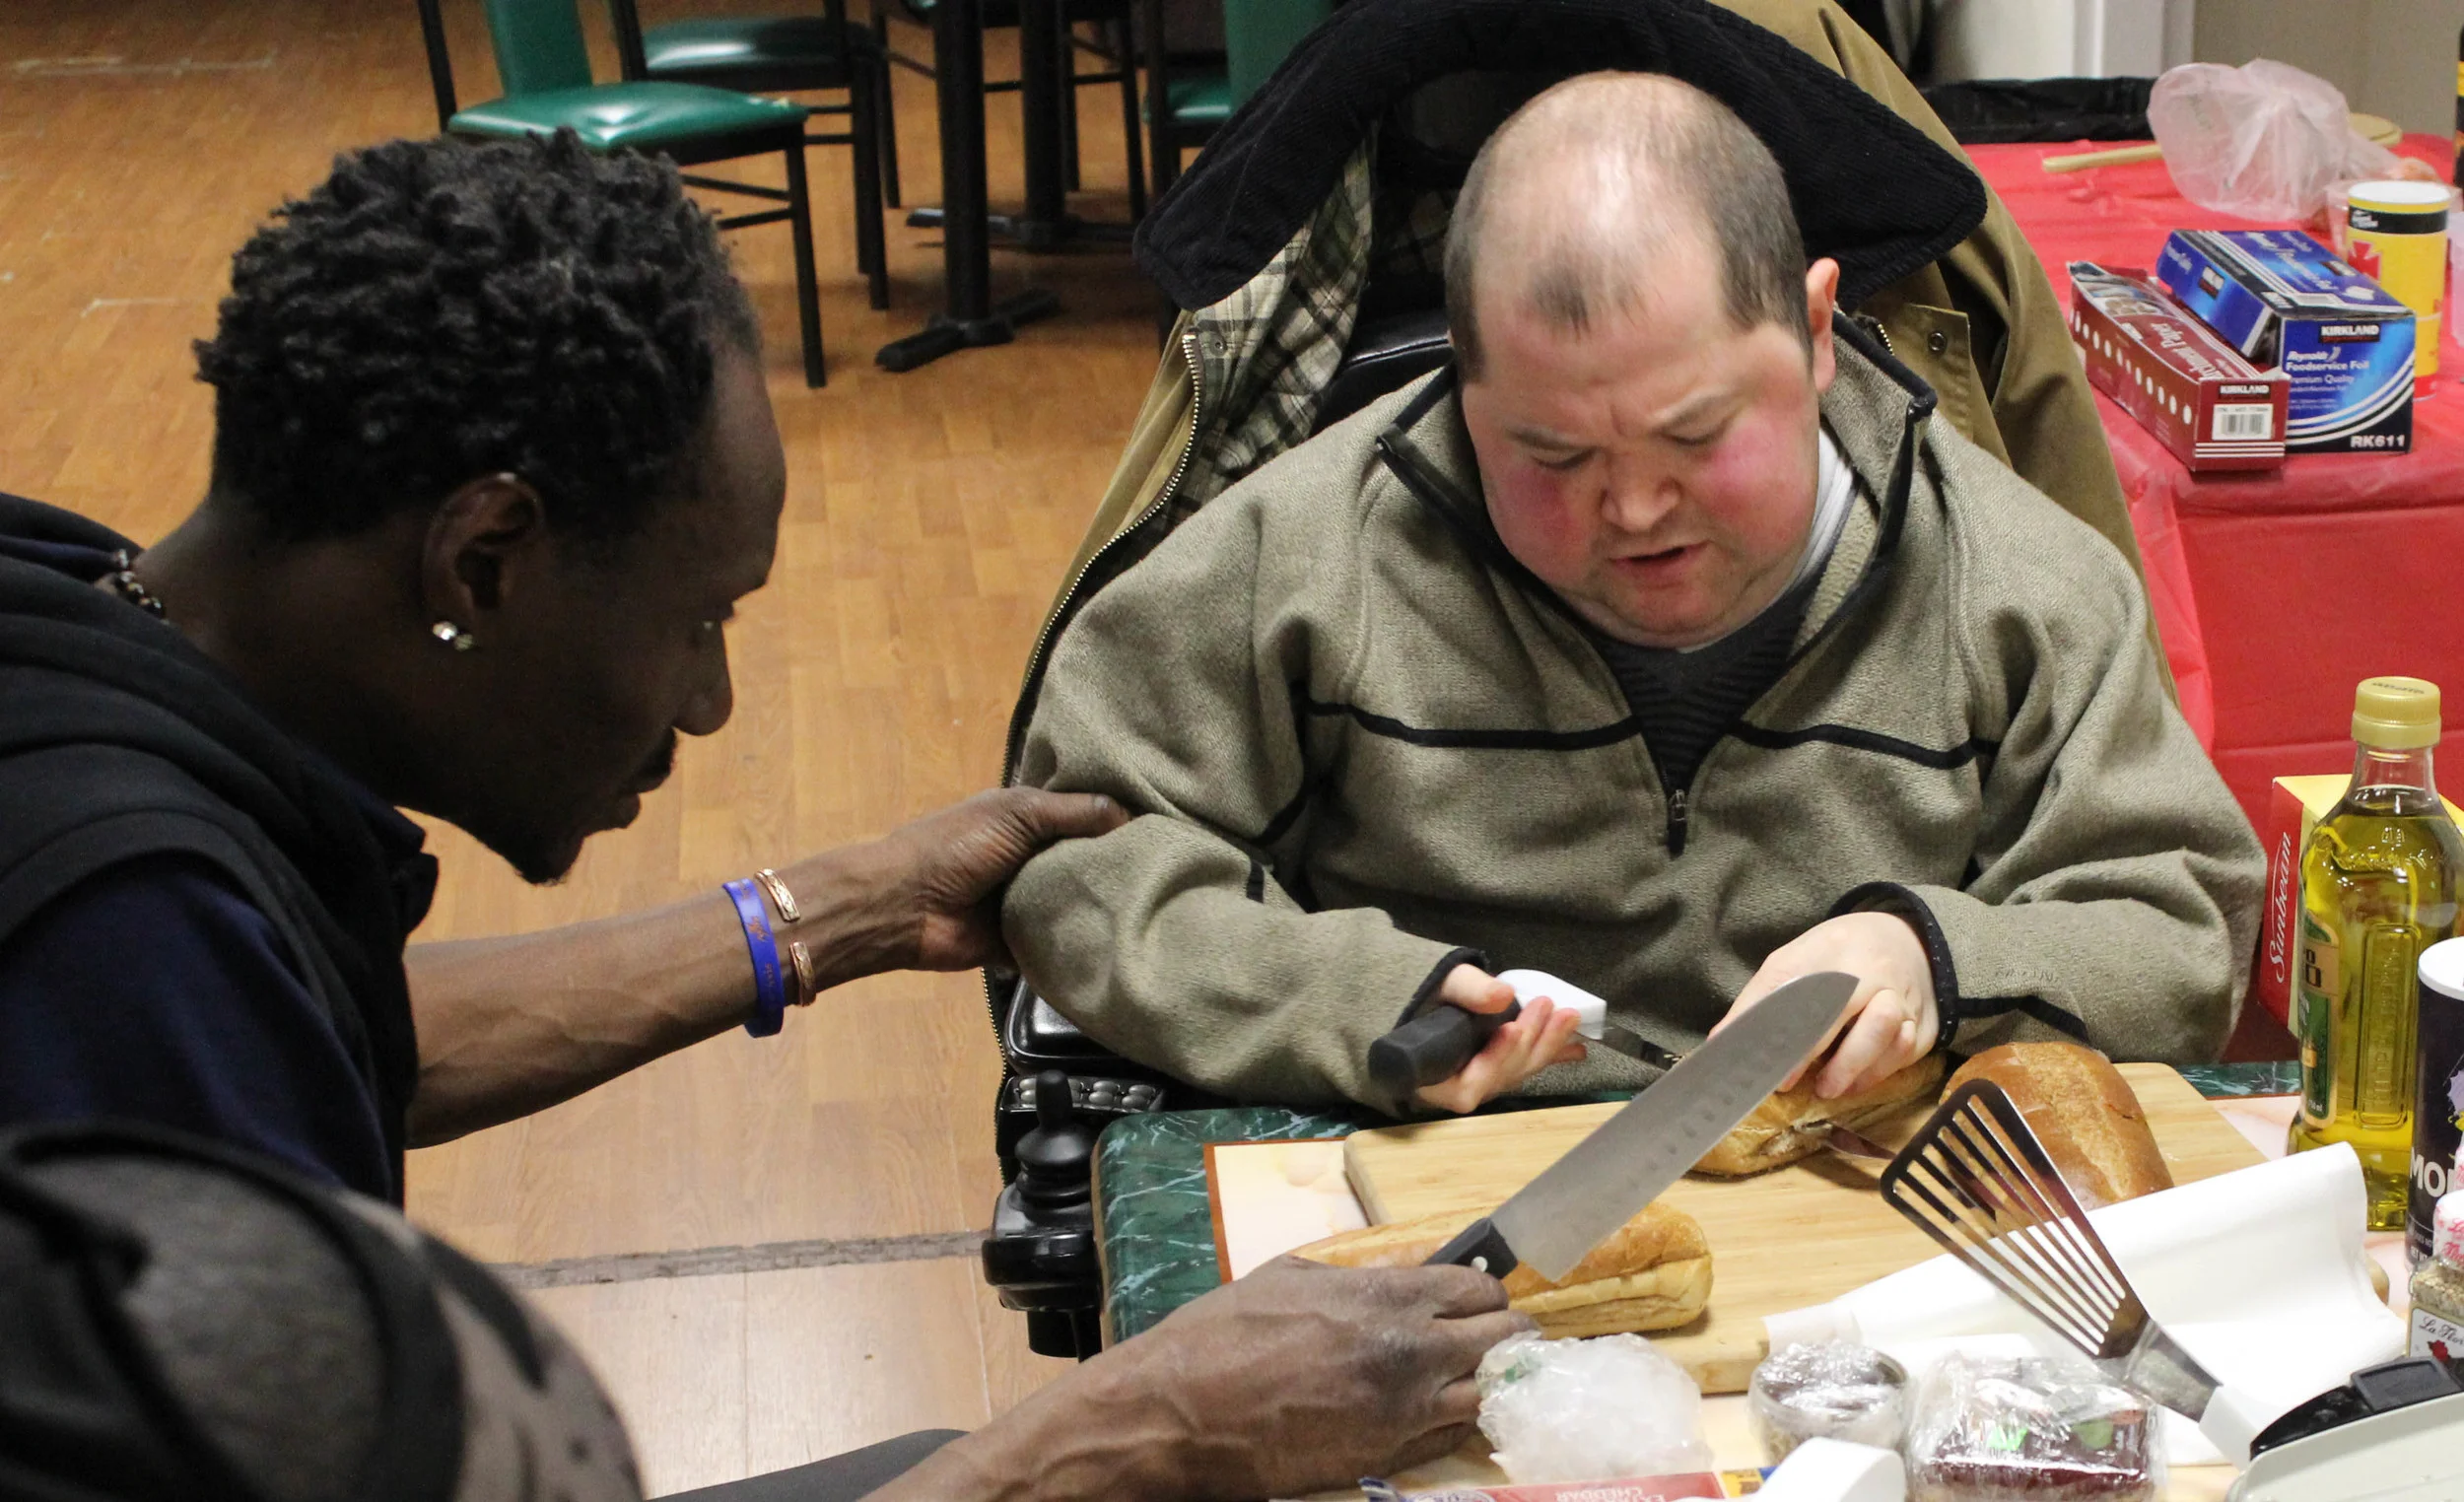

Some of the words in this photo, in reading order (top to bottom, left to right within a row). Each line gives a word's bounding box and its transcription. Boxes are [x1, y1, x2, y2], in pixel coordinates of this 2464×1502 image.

[2151, 322, 2188, 349] Paper
[2320, 324, 2380, 336] KIRKLAND
[2287, 361, 2348, 372] Foodservice
[2350, 361, 2370, 370] Foil
[2324, 374, 2355, 384] Quality
[2220, 384, 2270, 394] KIRKLAND
[2350, 435, 2405, 448] RK611
[2269, 831, 2292, 984] Sunbeam
[2418, 1316, 2436, 1334] La
